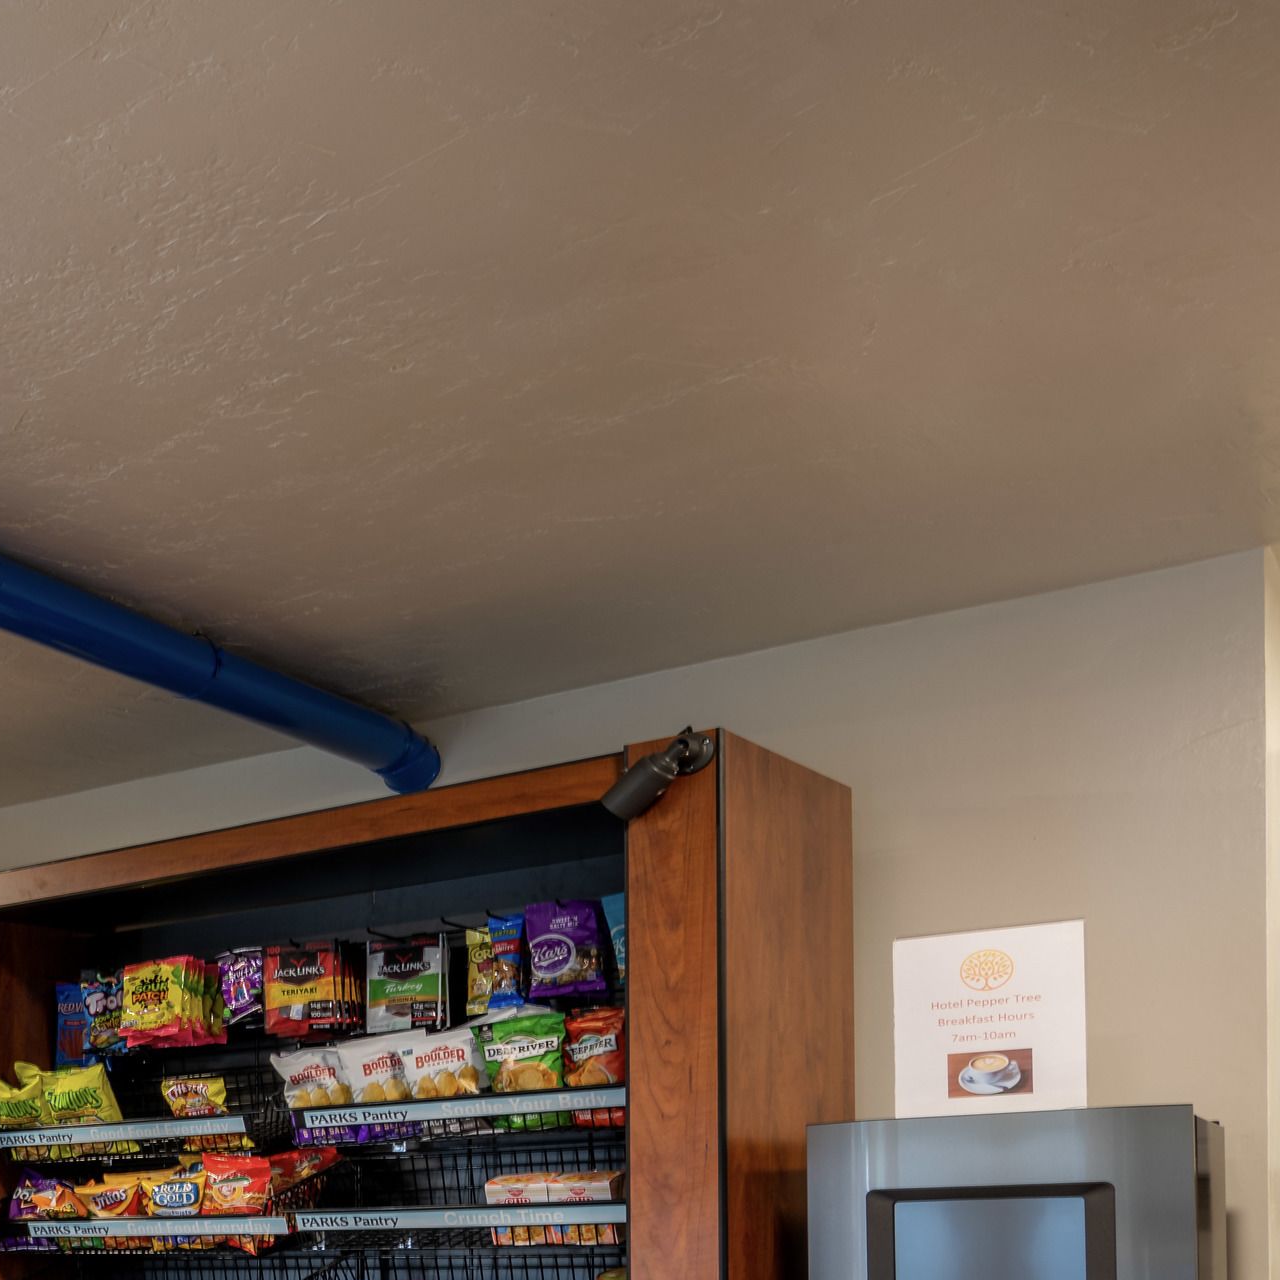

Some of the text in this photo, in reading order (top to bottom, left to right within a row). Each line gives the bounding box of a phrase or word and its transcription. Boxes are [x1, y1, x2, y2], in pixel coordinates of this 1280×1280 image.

[274, 967, 297, 979] JACK
[135, 981, 169, 993] SOUR
[281, 986, 317, 996] TERIYAKI
[131, 992, 168, 1004] PATCH
[931, 993, 1042, 1012] Hotel Pepper Tree
[937, 1011, 1035, 1027] Breakfast Hours
[952, 1030, 1016, 1043] 7am-10am
[517, 1039, 558, 1054] RIVER
[362, 1056, 403, 1077] BOULDE
[415, 1048, 466, 1071] BOULDER
[310, 1112, 357, 1125] PARKS
[362, 1109, 408, 1123] Pantry
[0, 1133, 36, 1146] PARKS
[38, 1131, 73, 1145] Pantry
[156, 1182, 192, 1194] ROLD
[154, 1193, 195, 1205] GOLD
[301, 1208, 564, 1229] PARKS Pantry Crunch Time
[33, 1225, 70, 1236] PARKS
[74, 1224, 109, 1236] Pantry
